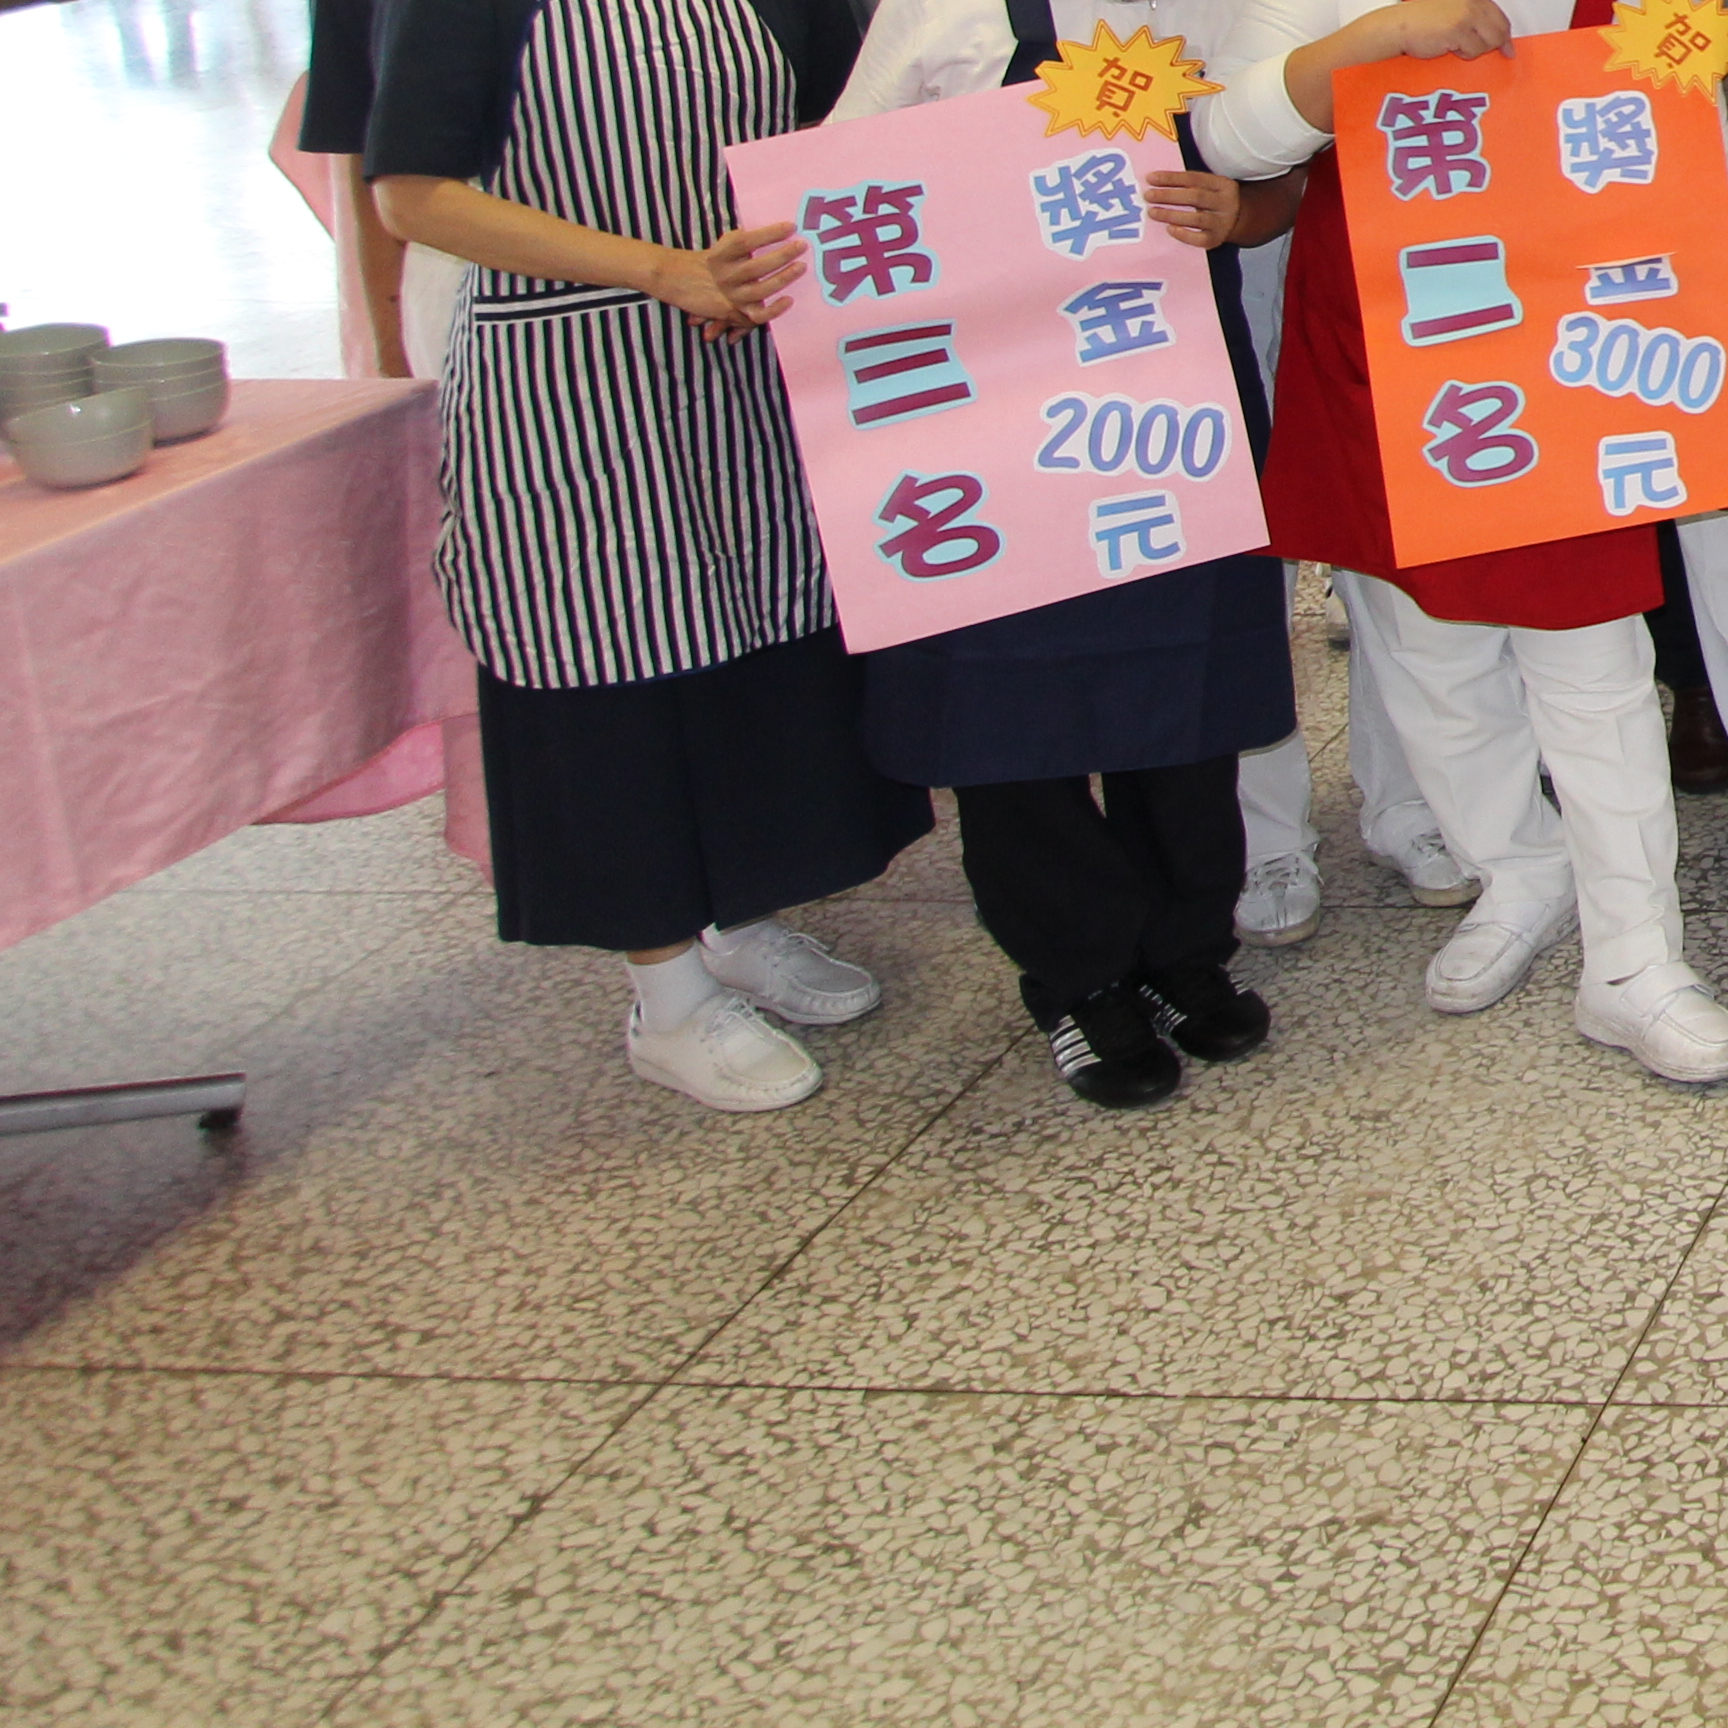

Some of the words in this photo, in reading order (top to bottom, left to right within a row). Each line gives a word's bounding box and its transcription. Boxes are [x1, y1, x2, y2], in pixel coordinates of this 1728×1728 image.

[1094, 56, 1153, 119] 賀
[1656, 12, 1711, 70] 賀
[802, 183, 1001, 579] 第三名
[1379, 92, 1535, 483] 第二名
